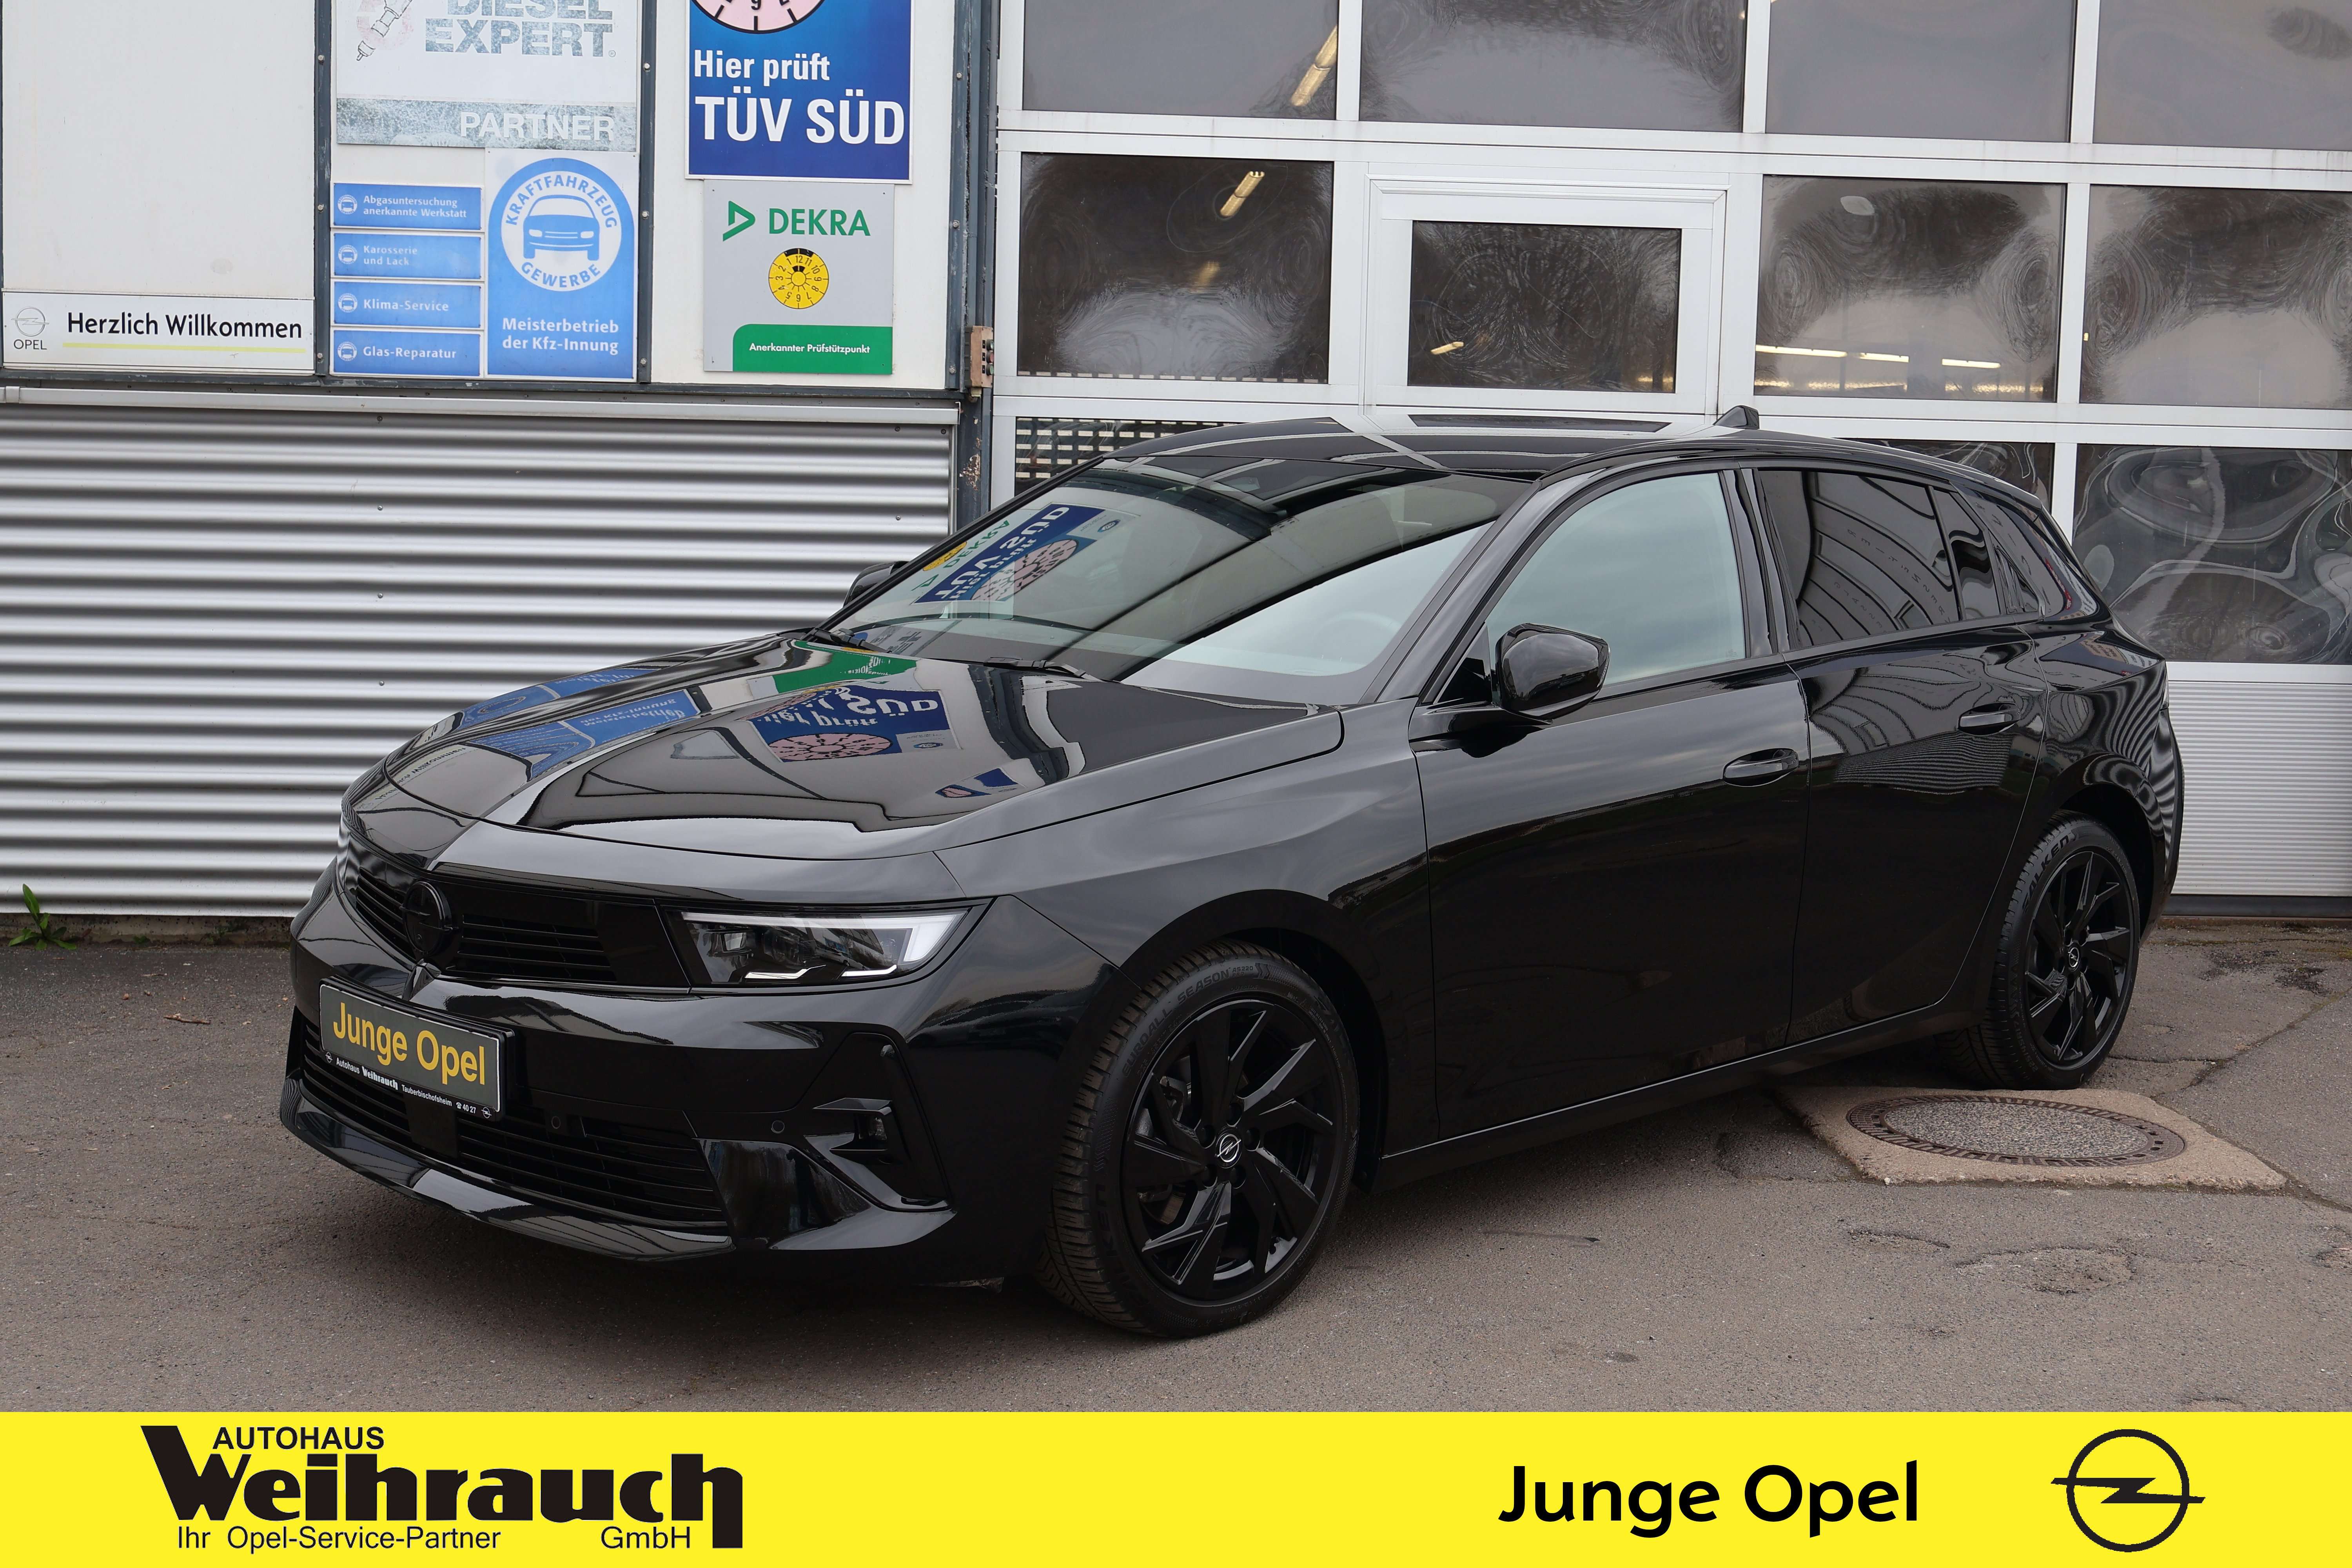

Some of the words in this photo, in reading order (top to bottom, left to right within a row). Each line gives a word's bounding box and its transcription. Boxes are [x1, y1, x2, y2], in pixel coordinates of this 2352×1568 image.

[694, 49, 755, 78] Hier
[764, 53, 830, 86] prüft
[461, 112, 614, 141] PARTNER
[695, 86, 792, 142] TÜV
[806, 89, 904, 144] SÜD
[363, 196, 457, 208] Abgasuntersuchung
[363, 207, 417, 216] anerkannte
[421, 209, 466, 218] Werkstatt
[506, 175, 617, 228] KRAFTFAHRZEUG
[769, 208, 871, 236] DEKRA
[363, 245, 417, 254] Karosserie
[363, 257, 382, 265] und
[387, 257, 409, 265] Lack
[521, 262, 601, 288] GEWERBE
[364, 299, 449, 311] Klima-Service
[68, 312, 158, 335] Herzlich
[165, 314, 301, 338] Willkommen
[503, 318, 619, 333] Meisterbetrieb
[13, 339, 47, 350] OPEL
[363, 346, 456, 360] Glas-Reparatur
[503, 335, 528, 349] der
[533, 336, 619, 355] Kfz-Innung
[749, 343, 805, 352] Anerkannter
[807, 344, 870, 355] Prüfstützpunkt
[1178, 969, 1231, 1005] SEASON
[333, 1002, 407, 1066] Junge
[417, 1030, 485, 1085] Opel
[336, 1057, 360, 1074] Autohaus
[362, 1066, 398, 1090] Weihrauch
[401, 1084, 452, 1107] Tauberbischofsheim
